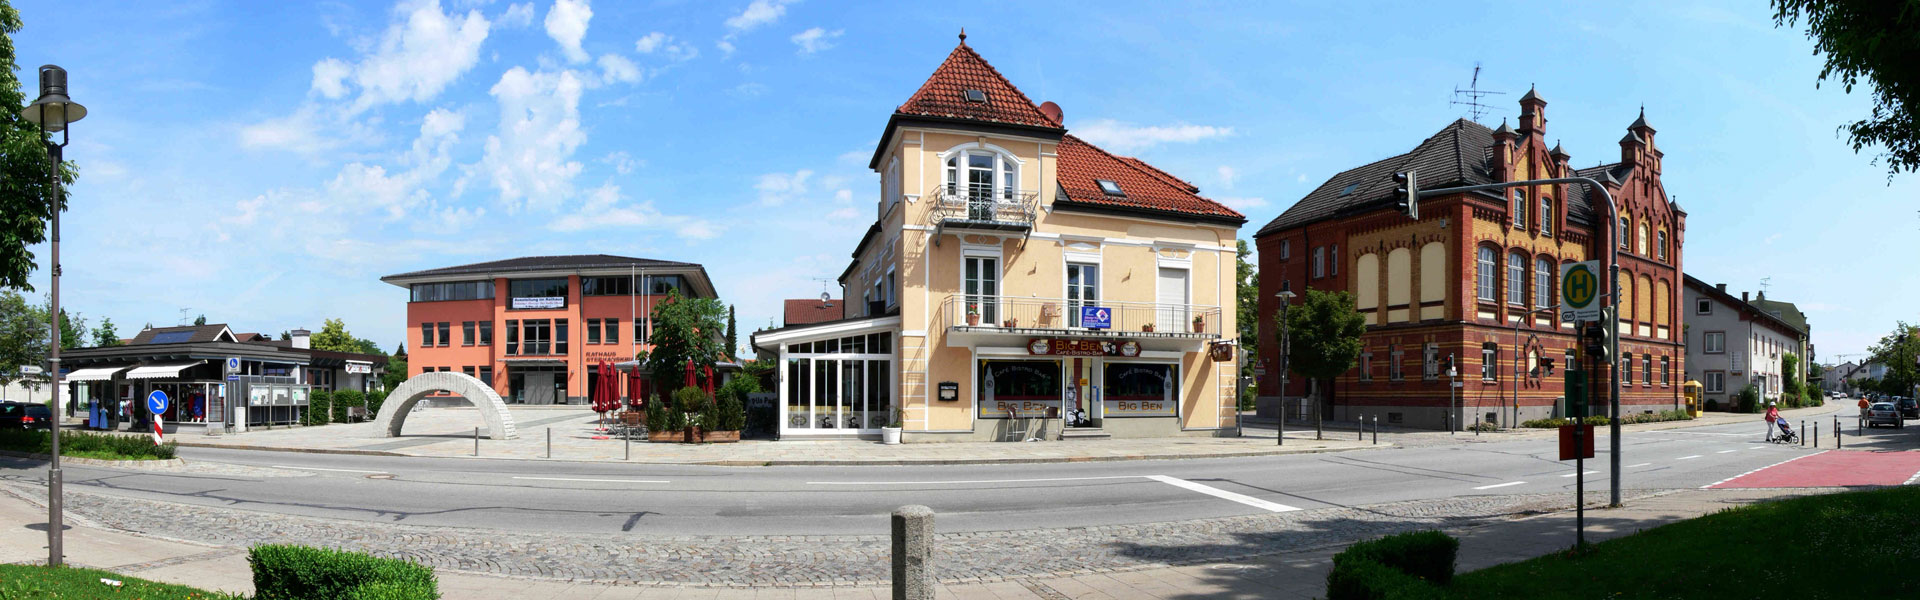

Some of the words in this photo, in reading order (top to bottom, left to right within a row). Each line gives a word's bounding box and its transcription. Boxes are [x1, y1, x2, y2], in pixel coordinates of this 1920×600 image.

[1572, 274, 1587, 298] H
[1118, 401, 1137, 411] BIG
[1141, 401, 1163, 411] BEN
